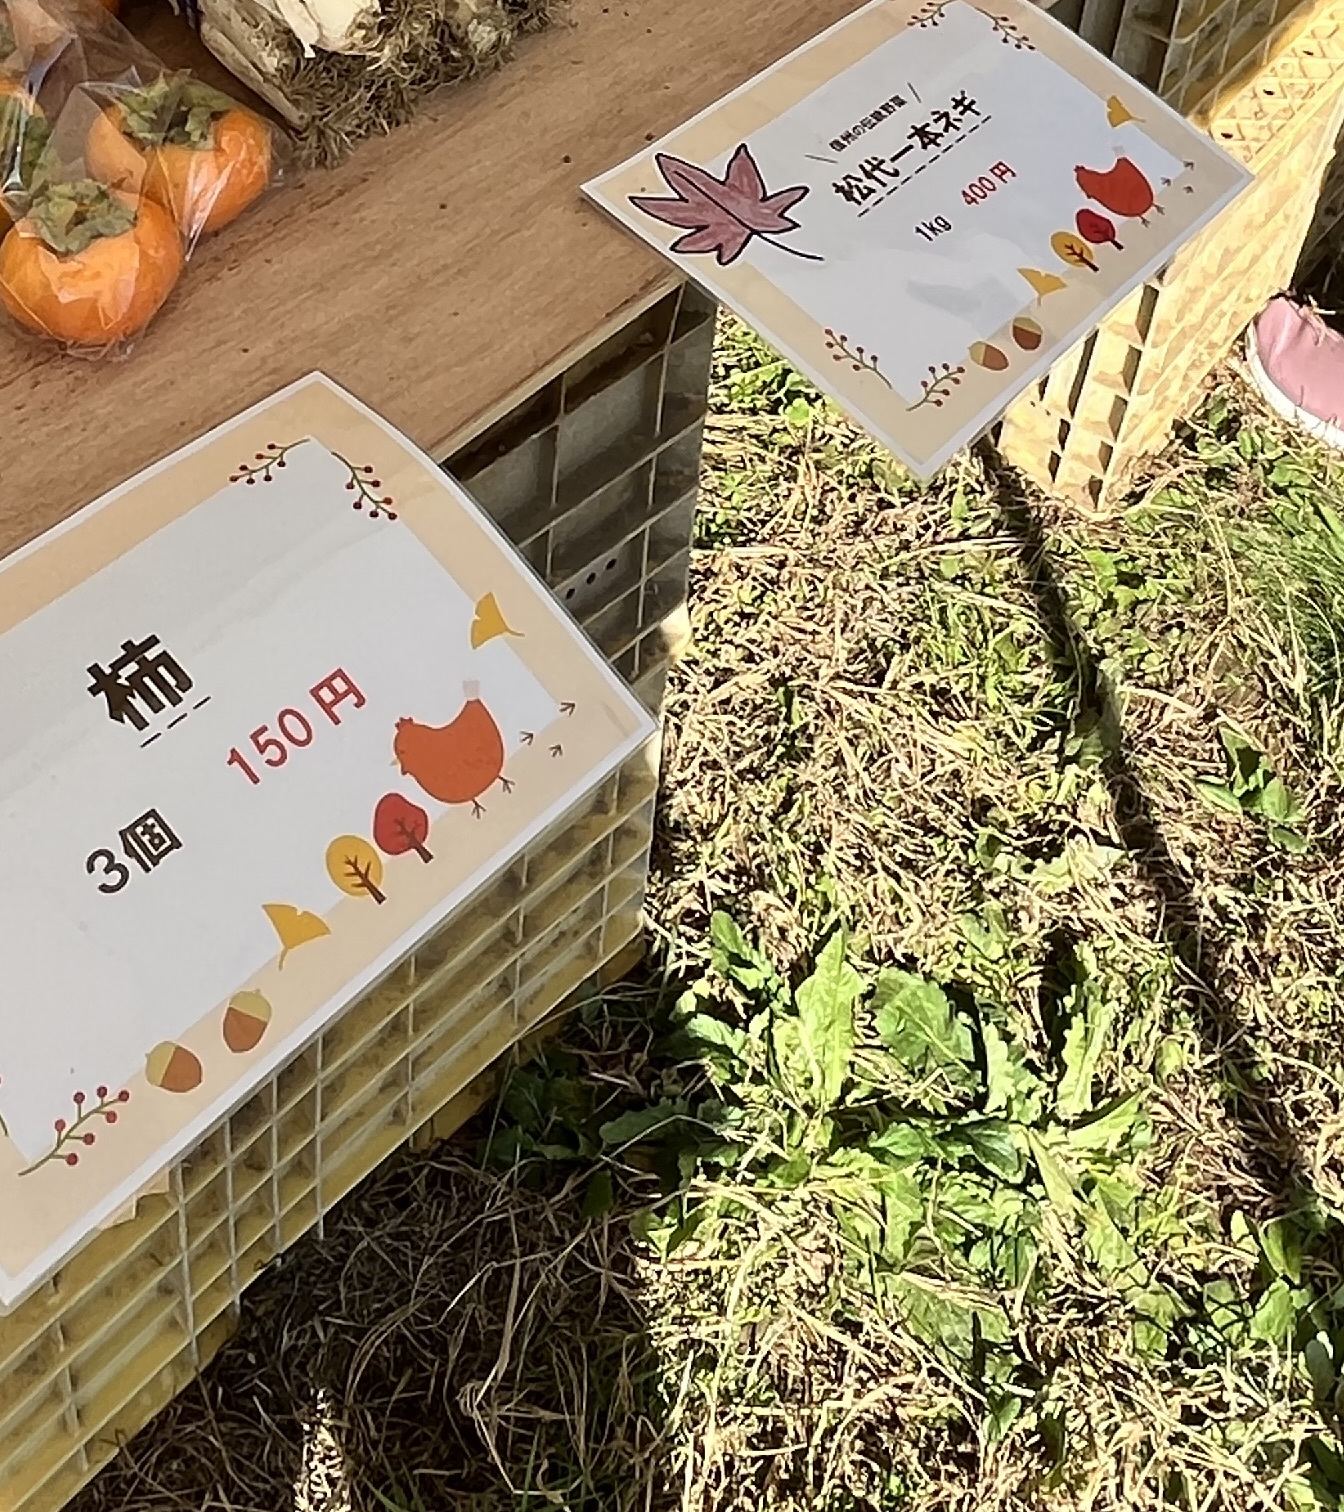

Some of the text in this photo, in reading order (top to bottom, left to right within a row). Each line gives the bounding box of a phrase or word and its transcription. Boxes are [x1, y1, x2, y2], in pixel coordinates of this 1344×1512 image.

[832, 90, 981, 206] 松代一本ネギ
[914, 215, 953, 241] 1kg
[86, 633, 194, 732] 柿
[85, 808, 184, 894] 3個
